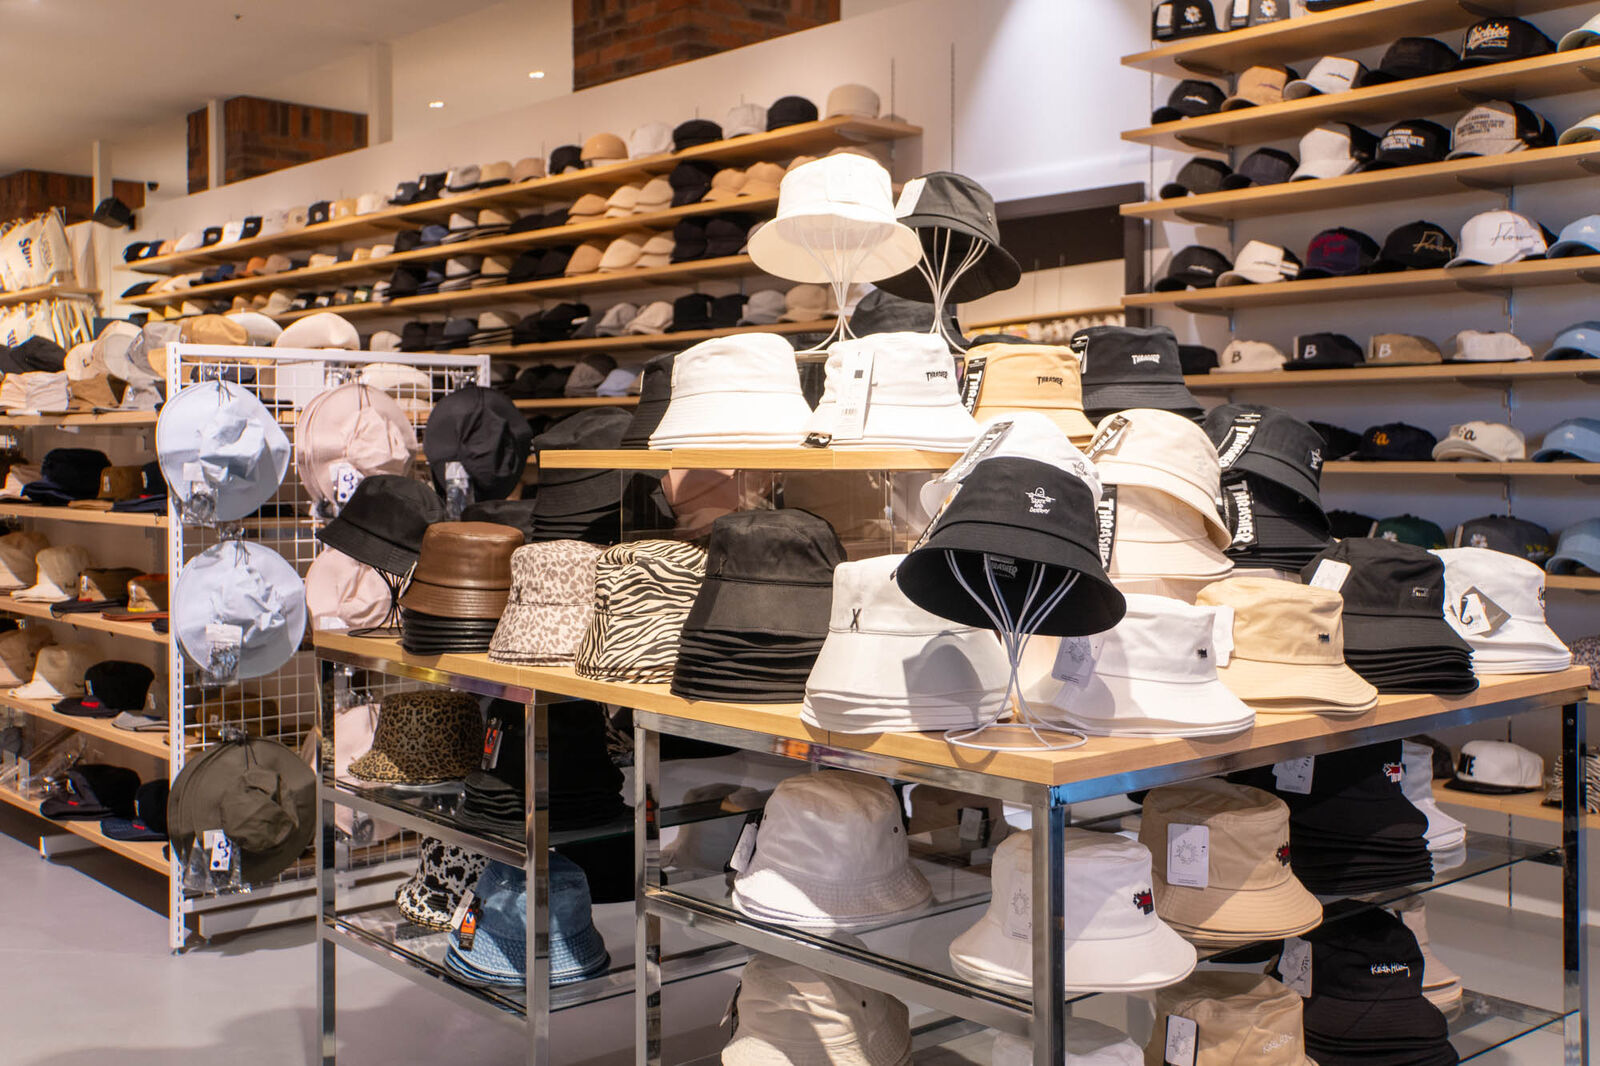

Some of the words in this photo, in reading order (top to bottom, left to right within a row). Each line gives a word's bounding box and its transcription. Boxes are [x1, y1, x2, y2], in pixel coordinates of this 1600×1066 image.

[1231, 351, 1242, 363] B
[1303, 344, 1318, 359] B
[1378, 343, 1392, 358] B
[1226, 480, 1255, 544] THRASHER
